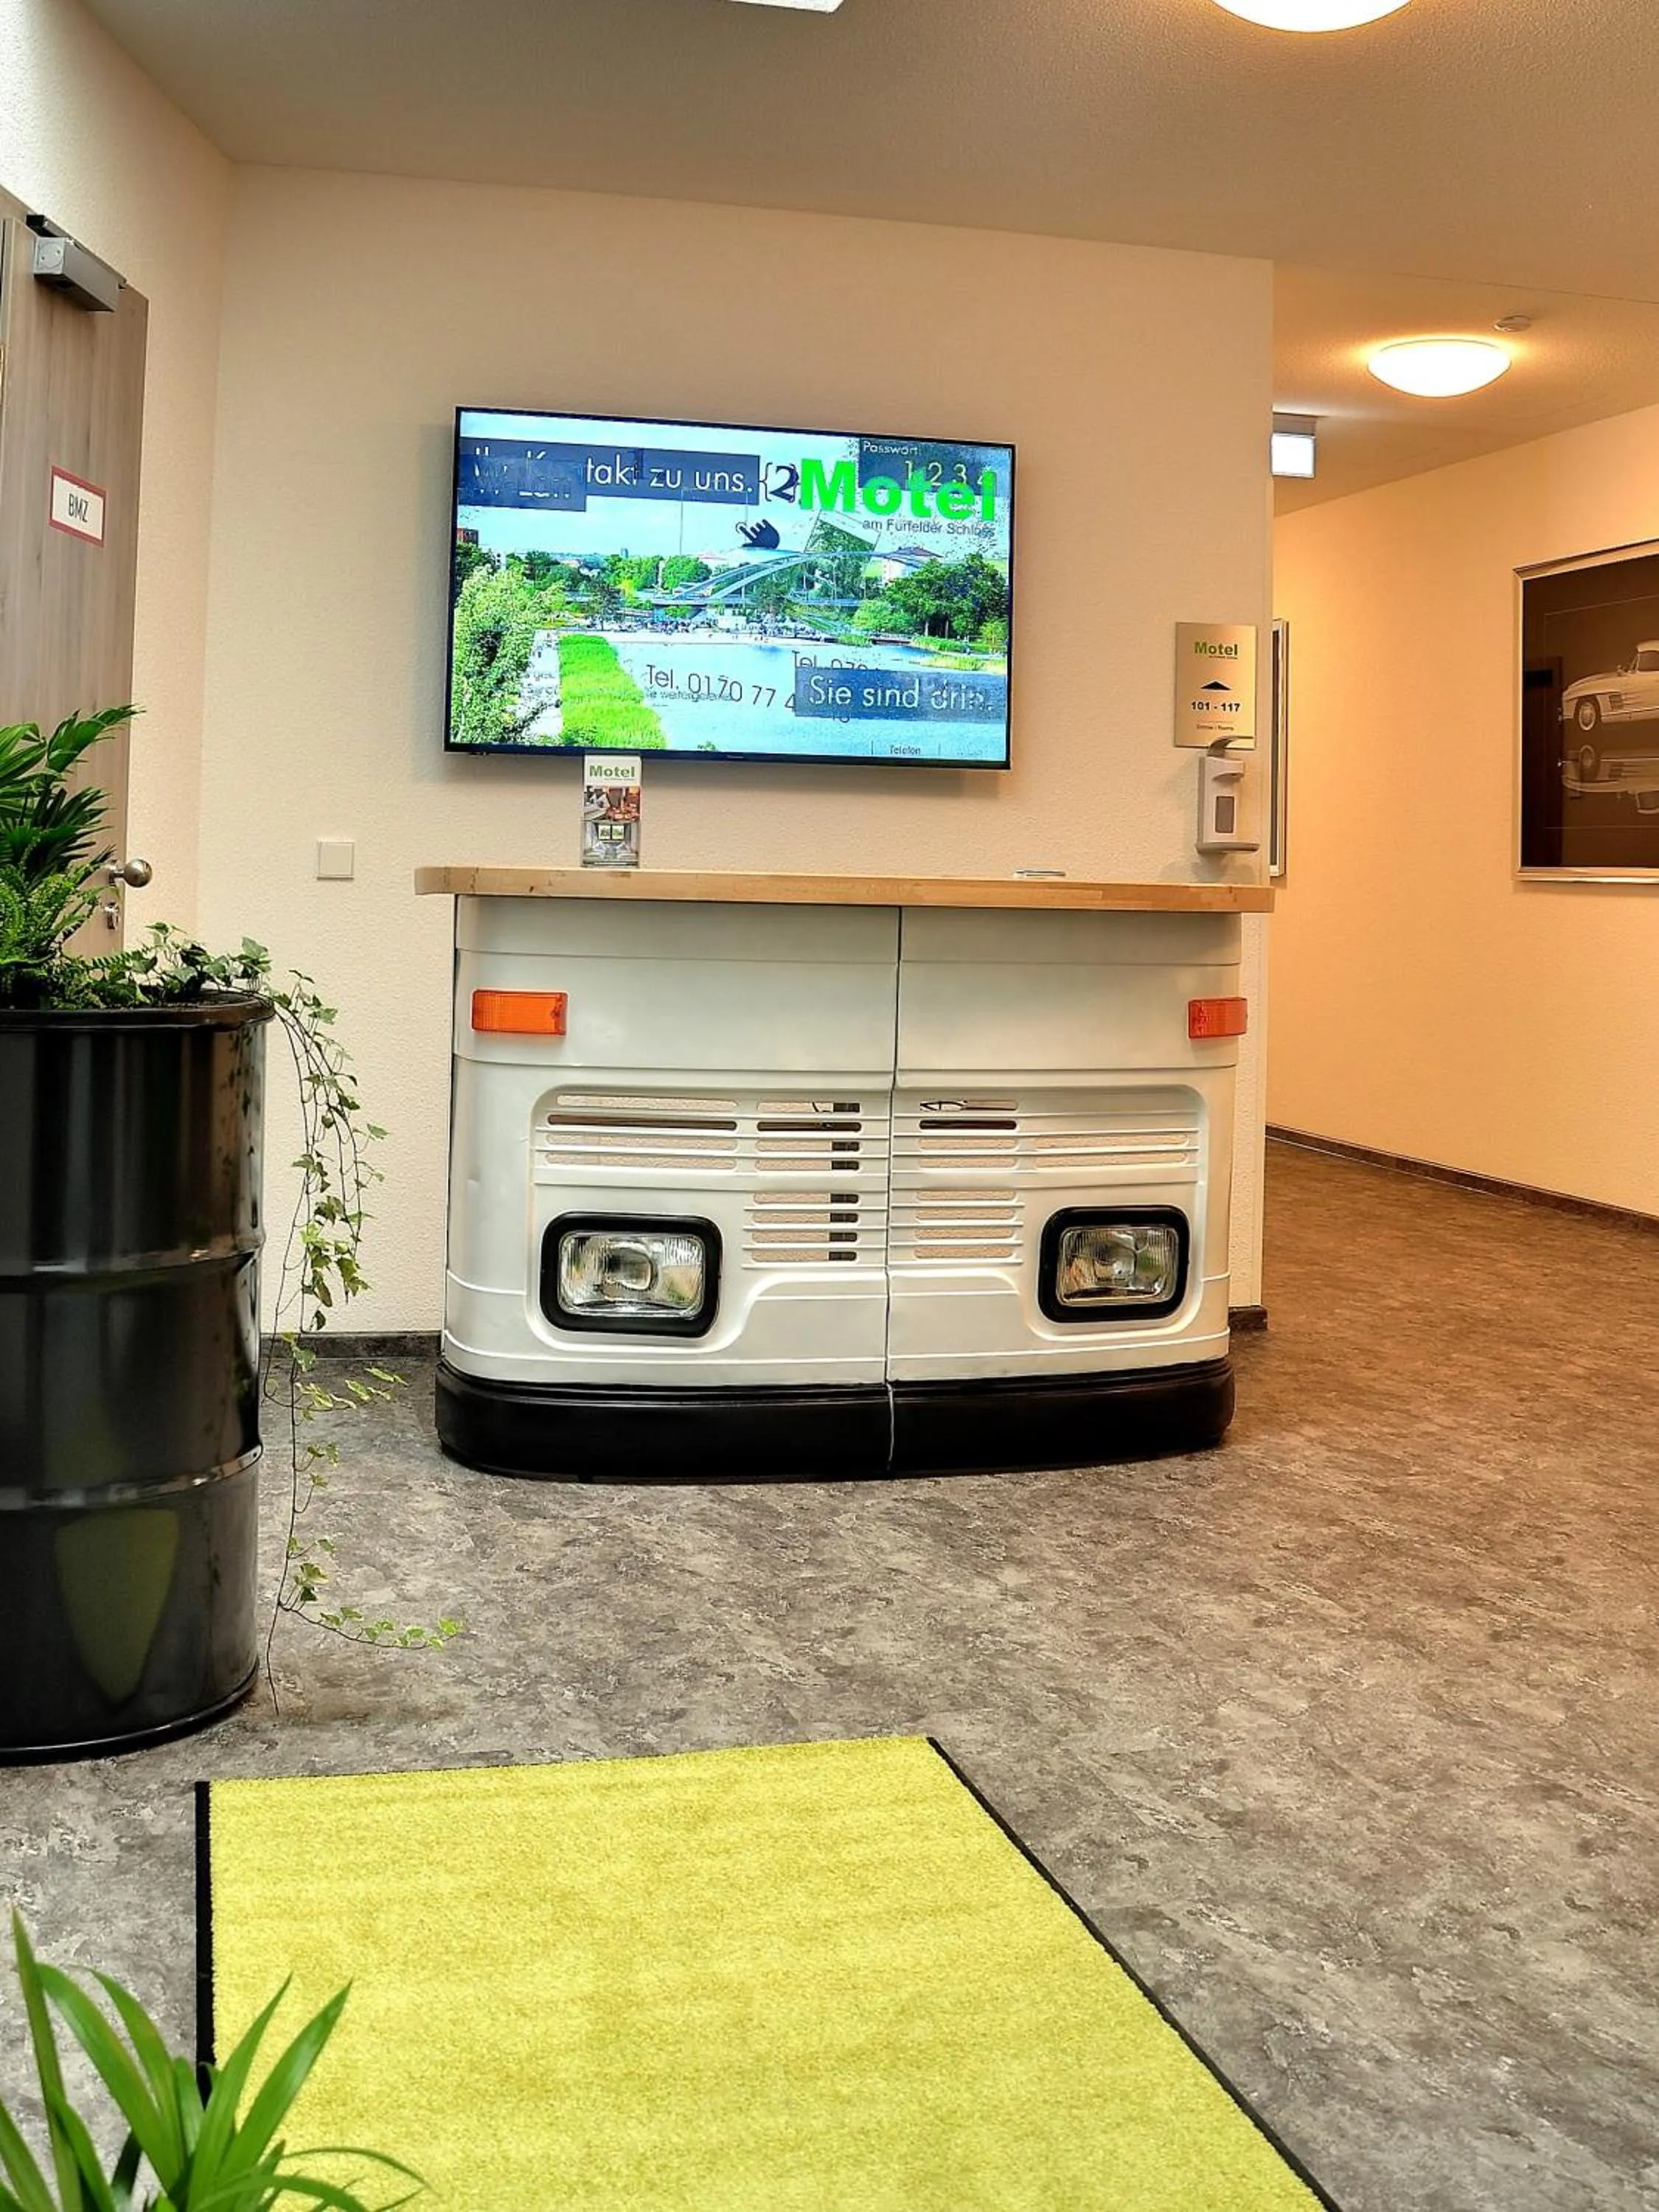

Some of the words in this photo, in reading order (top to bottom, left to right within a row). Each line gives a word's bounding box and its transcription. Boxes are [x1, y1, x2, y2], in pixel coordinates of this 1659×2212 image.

[650, 467, 682, 489] zu
[695, 470, 753, 493] uns.
[800, 458, 997, 521] Motel
[862, 519, 883, 530] am
[1194, 641, 1238, 655] Motel
[646, 664, 679, 689] Tel.
[688, 672, 743, 702] 0170
[751, 685, 776, 708] 77
[809, 675, 852, 706] Sie
[862, 678, 920, 709] sind
[1192, 701, 1210, 711] 101
[1221, 703, 1240, 712] 117
[589, 765, 635, 778] Motel
